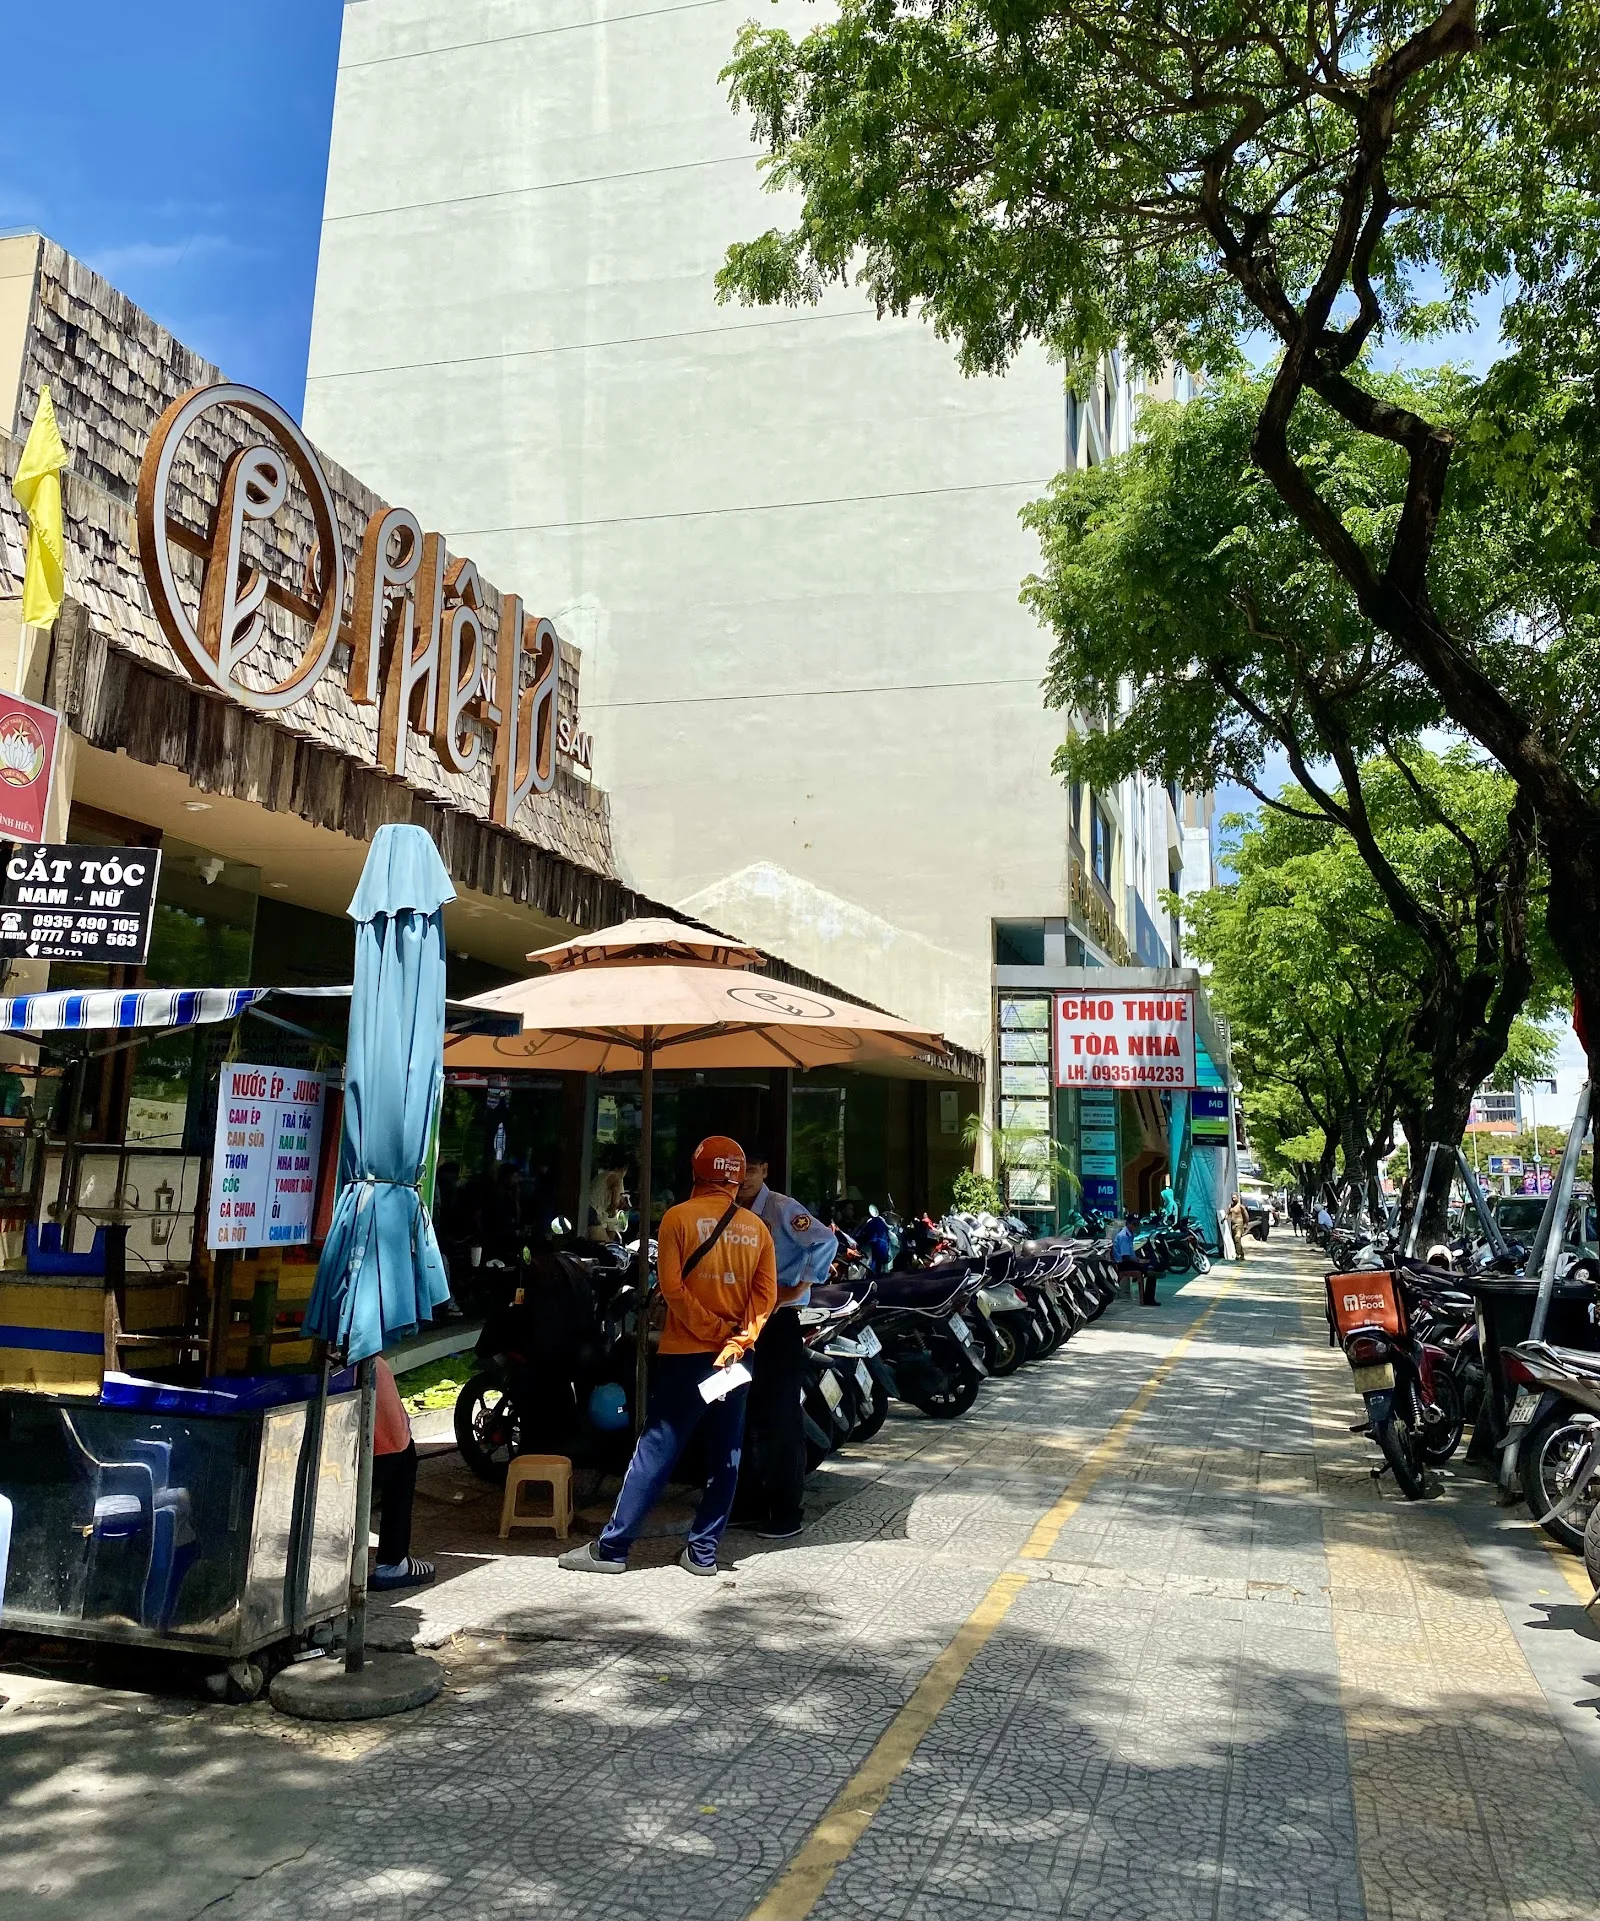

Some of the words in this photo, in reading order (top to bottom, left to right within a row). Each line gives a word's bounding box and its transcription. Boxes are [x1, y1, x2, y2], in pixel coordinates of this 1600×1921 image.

[6, 847, 72, 883] CẮT
[80, 856, 146, 886] TÓC
[18, 887, 69, 904] NAM
[89, 889, 125, 907] NỮ
[32, 914, 73, 929] 0935
[76, 917, 107, 930] 490
[111, 919, 140, 932] 105
[31, 929, 64, 943] 0777
[70, 931, 98, 945] 516
[106, 933, 137, 947] 563
[41, 946, 83, 957] 30m
[1062, 1000, 1114, 1021] CHO
[1122, 998, 1187, 1021] THUÊ
[1070, 1032, 1119, 1056] TÒA
[1128, 1032, 1181, 1057] NHÀ
[1068, 1064, 1088, 1080] LH:
[1092, 1065, 1184, 1082] 0935144233
[232, 1070, 267, 1097] NƯỚC
[270, 1071, 284, 1099] ÉP
[293, 1080, 321, 1103] JUICE
[1208, 1100, 1224, 1109] MB
[229, 1108, 248, 1125] CAM
[250, 1106, 261, 1125] ÉP
[282, 1109, 296, 1129] TRÀ
[299, 1109, 312, 1129] TẮC
[227, 1131, 245, 1147] CAM
[279, 1135, 294, 1150] RAU
[225, 1153, 249, 1169] THƠM
[276, 1156, 292, 1170] NHA
[724, 1162, 741, 1172] Food
[222, 1174, 240, 1193] CÓC
[1098, 1185, 1114, 1195] MB
[220, 1198, 231, 1217] CÀ
[234, 1202, 256, 1217] CHUA
[271, 1194, 281, 1219] ỔI
[218, 1223, 229, 1242] CÀ
[232, 1220, 247, 1242] RỐT
[269, 1226, 292, 1241] CHANH
[723, 1230, 758, 1248] Food
[1359, 1293, 1383, 1301] Shopee
[1360, 1299, 1385, 1310] Food
